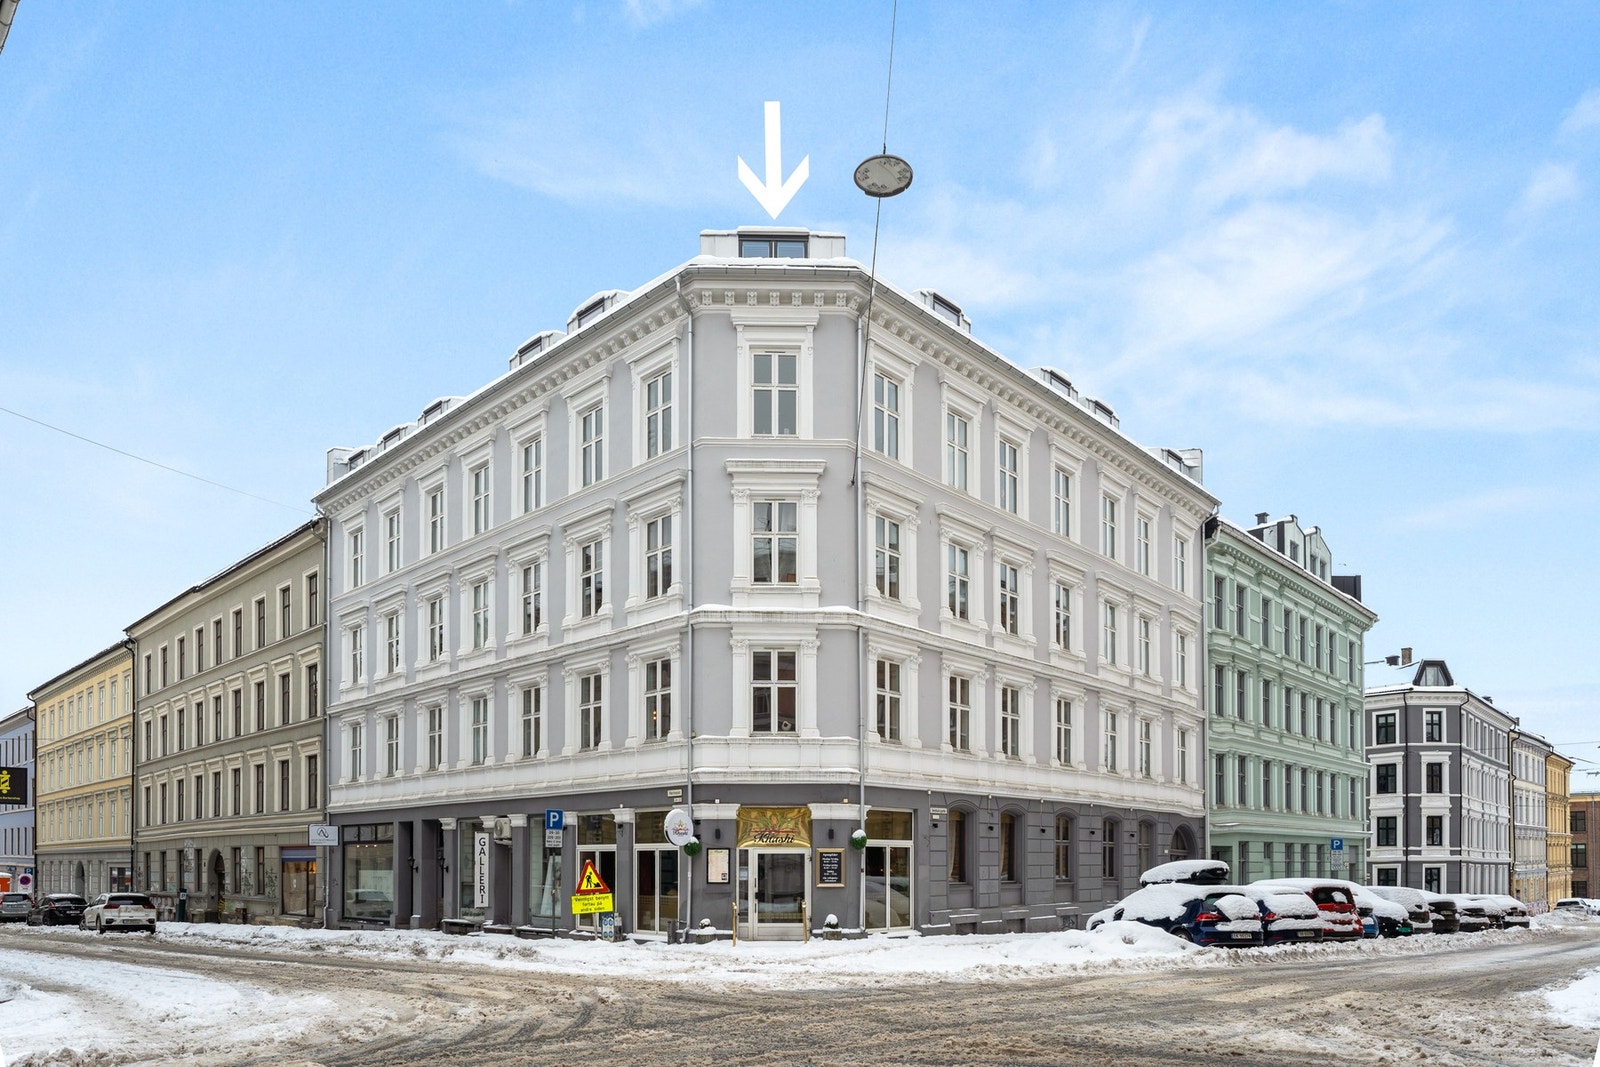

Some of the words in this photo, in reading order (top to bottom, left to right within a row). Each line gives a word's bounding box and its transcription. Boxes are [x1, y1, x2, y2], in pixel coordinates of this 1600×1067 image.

[550, 812, 559, 827] P
[753, 832, 794, 843] Khushi
[1333, 840, 1341, 849] P
[478, 837, 487, 904] GALLERI
